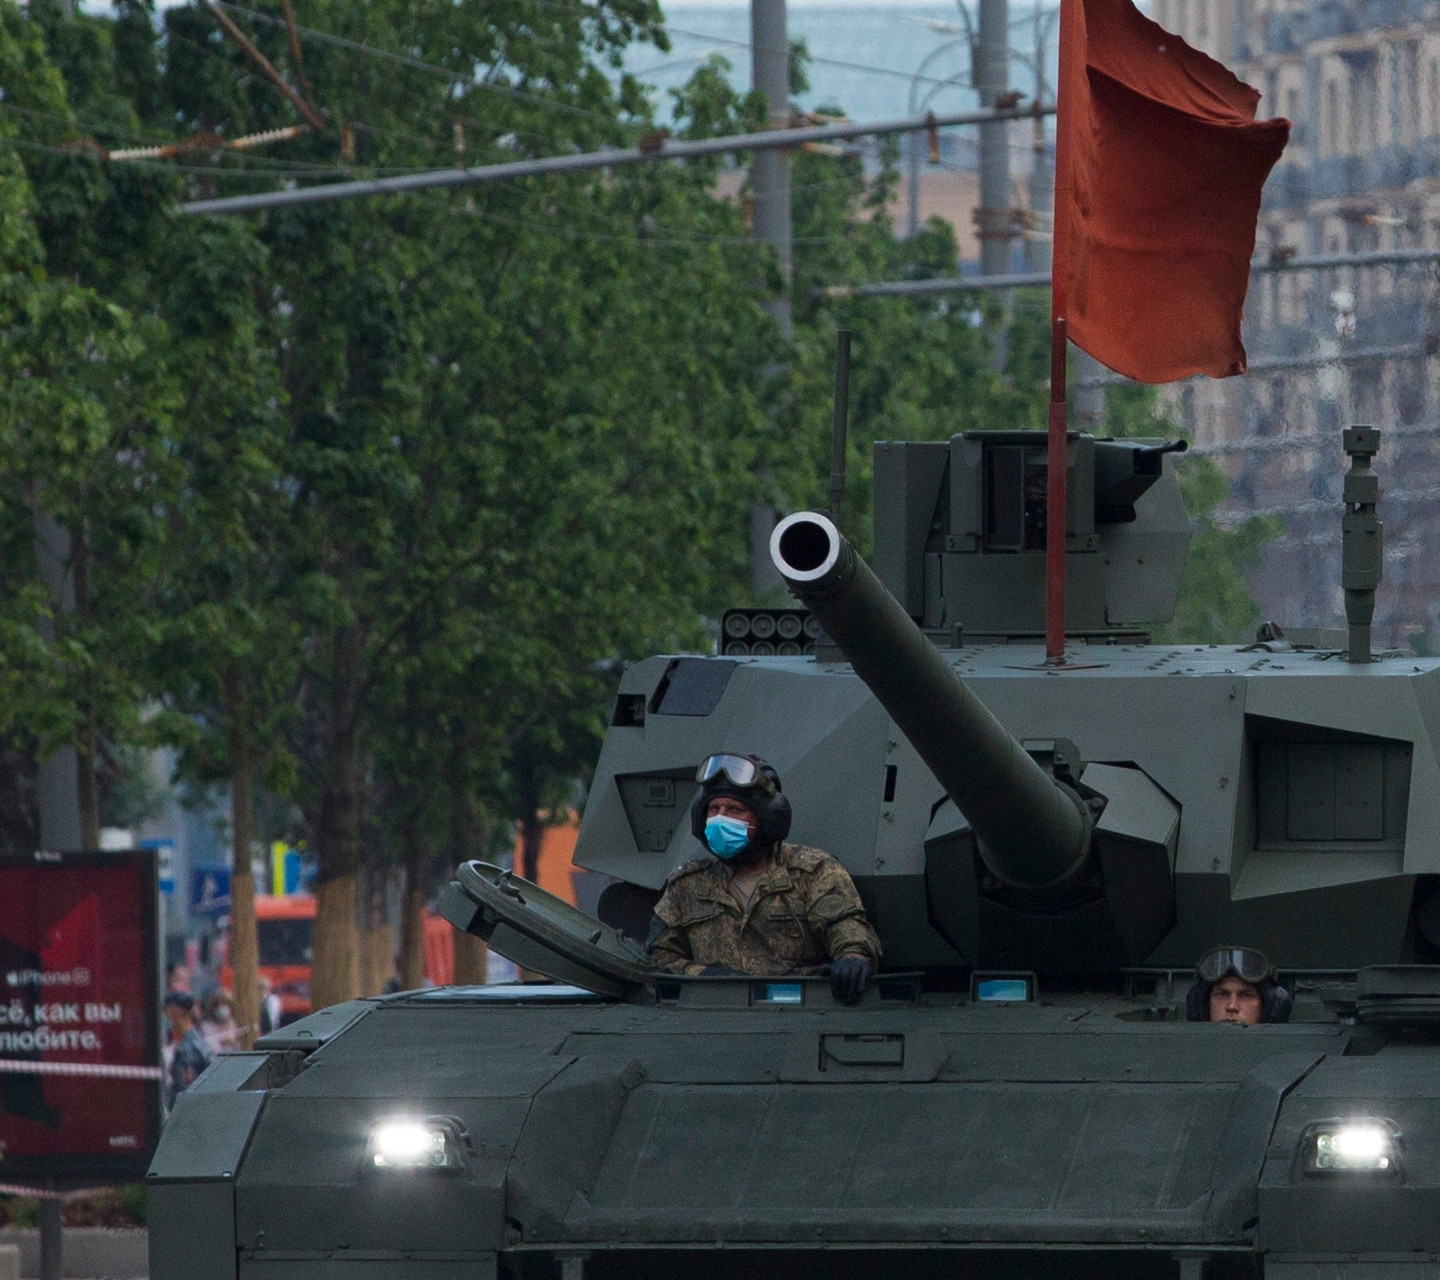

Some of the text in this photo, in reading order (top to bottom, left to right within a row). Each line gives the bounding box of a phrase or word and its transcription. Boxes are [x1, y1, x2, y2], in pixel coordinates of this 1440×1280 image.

[19, 969, 71, 985] iPhone
[33, 1003, 80, 1023] как
[84, 1002, 122, 1023] вы
